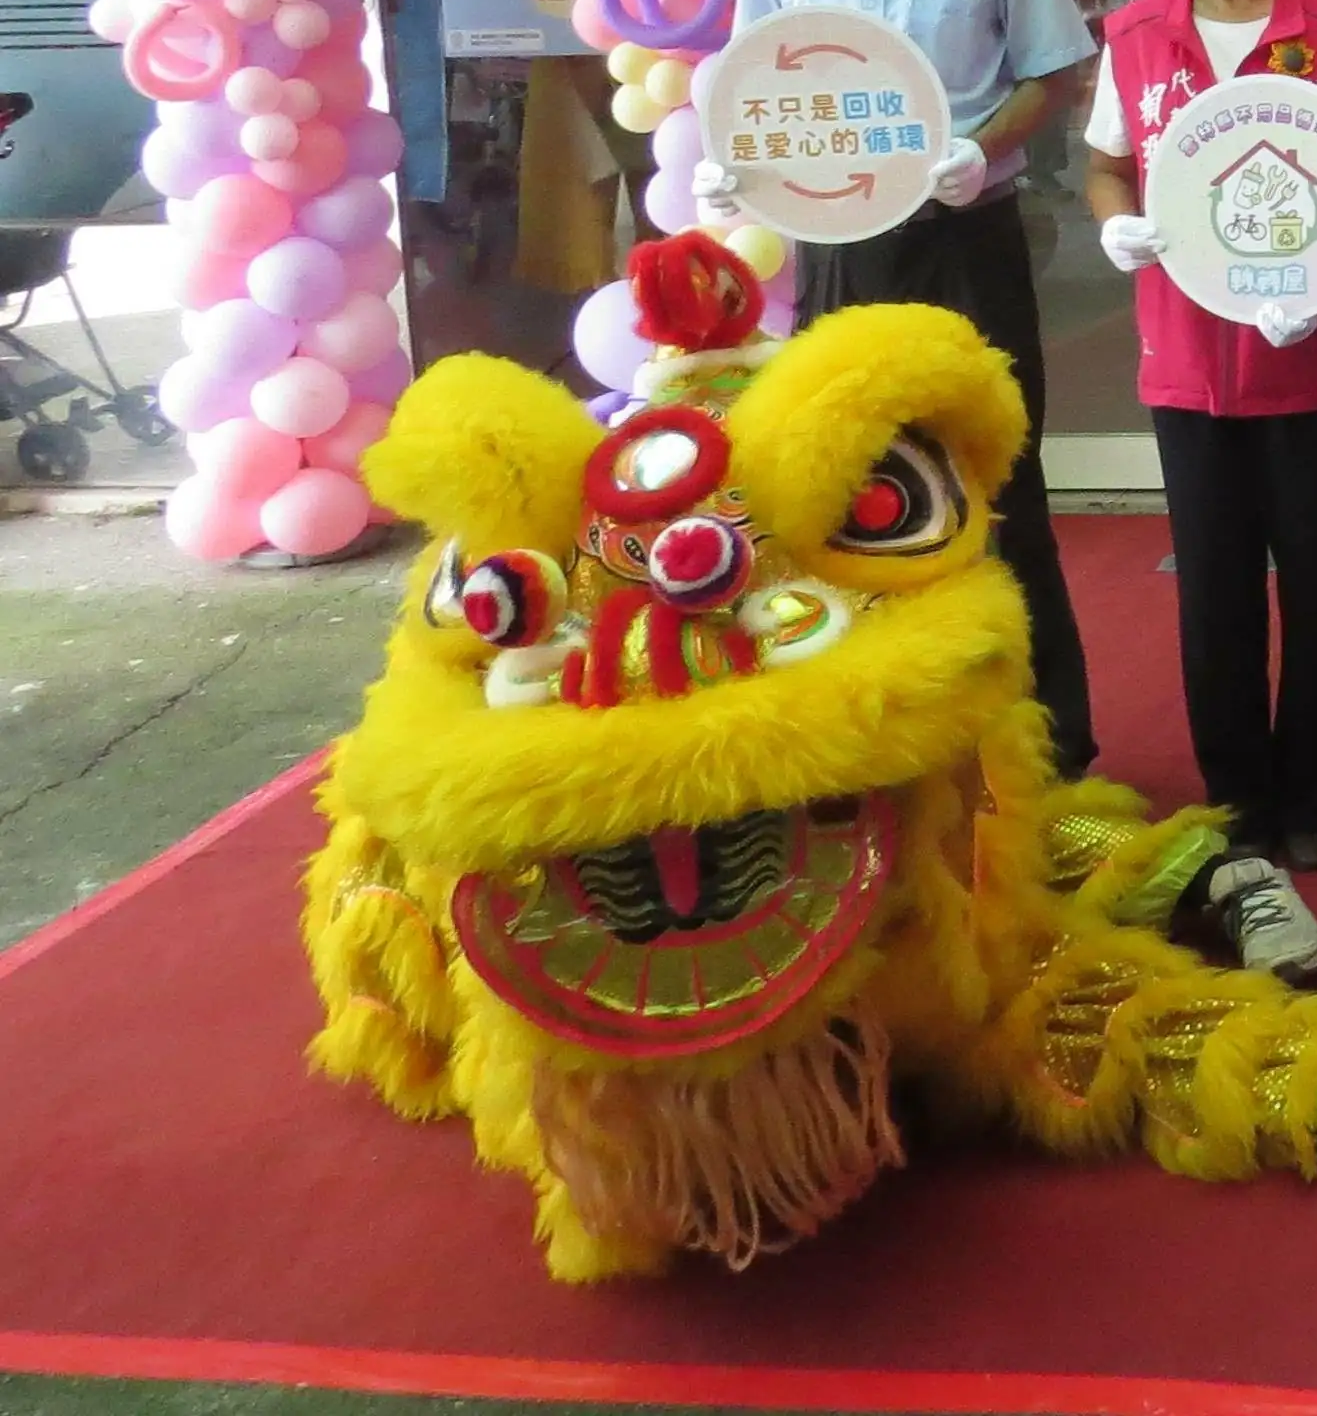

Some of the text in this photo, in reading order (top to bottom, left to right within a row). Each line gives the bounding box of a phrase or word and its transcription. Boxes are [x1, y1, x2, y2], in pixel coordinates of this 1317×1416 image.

[742, 90, 906, 126] 不只是回收
[731, 122, 927, 163] 是愛心的循環
[1228, 263, 1308, 296] 轉轉屋
